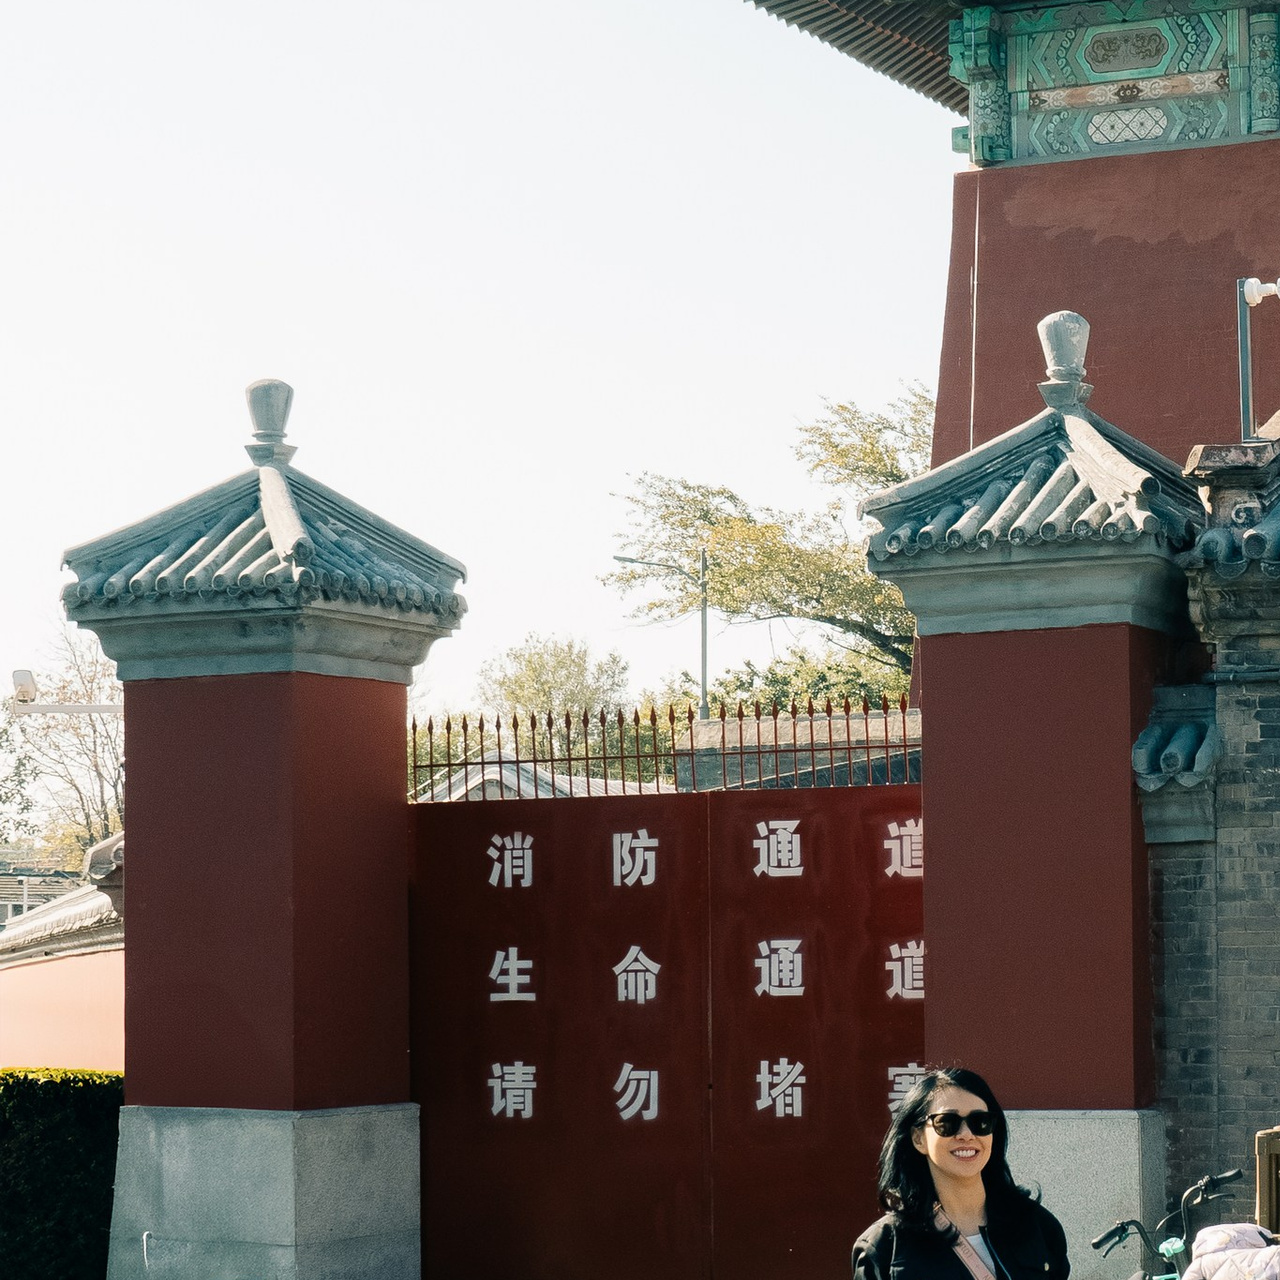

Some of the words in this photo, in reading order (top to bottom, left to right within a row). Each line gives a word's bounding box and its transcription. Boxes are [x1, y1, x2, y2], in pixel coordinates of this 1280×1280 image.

[486, 818, 924, 888] 消防通道
[488, 939, 926, 1004] 生命通道
